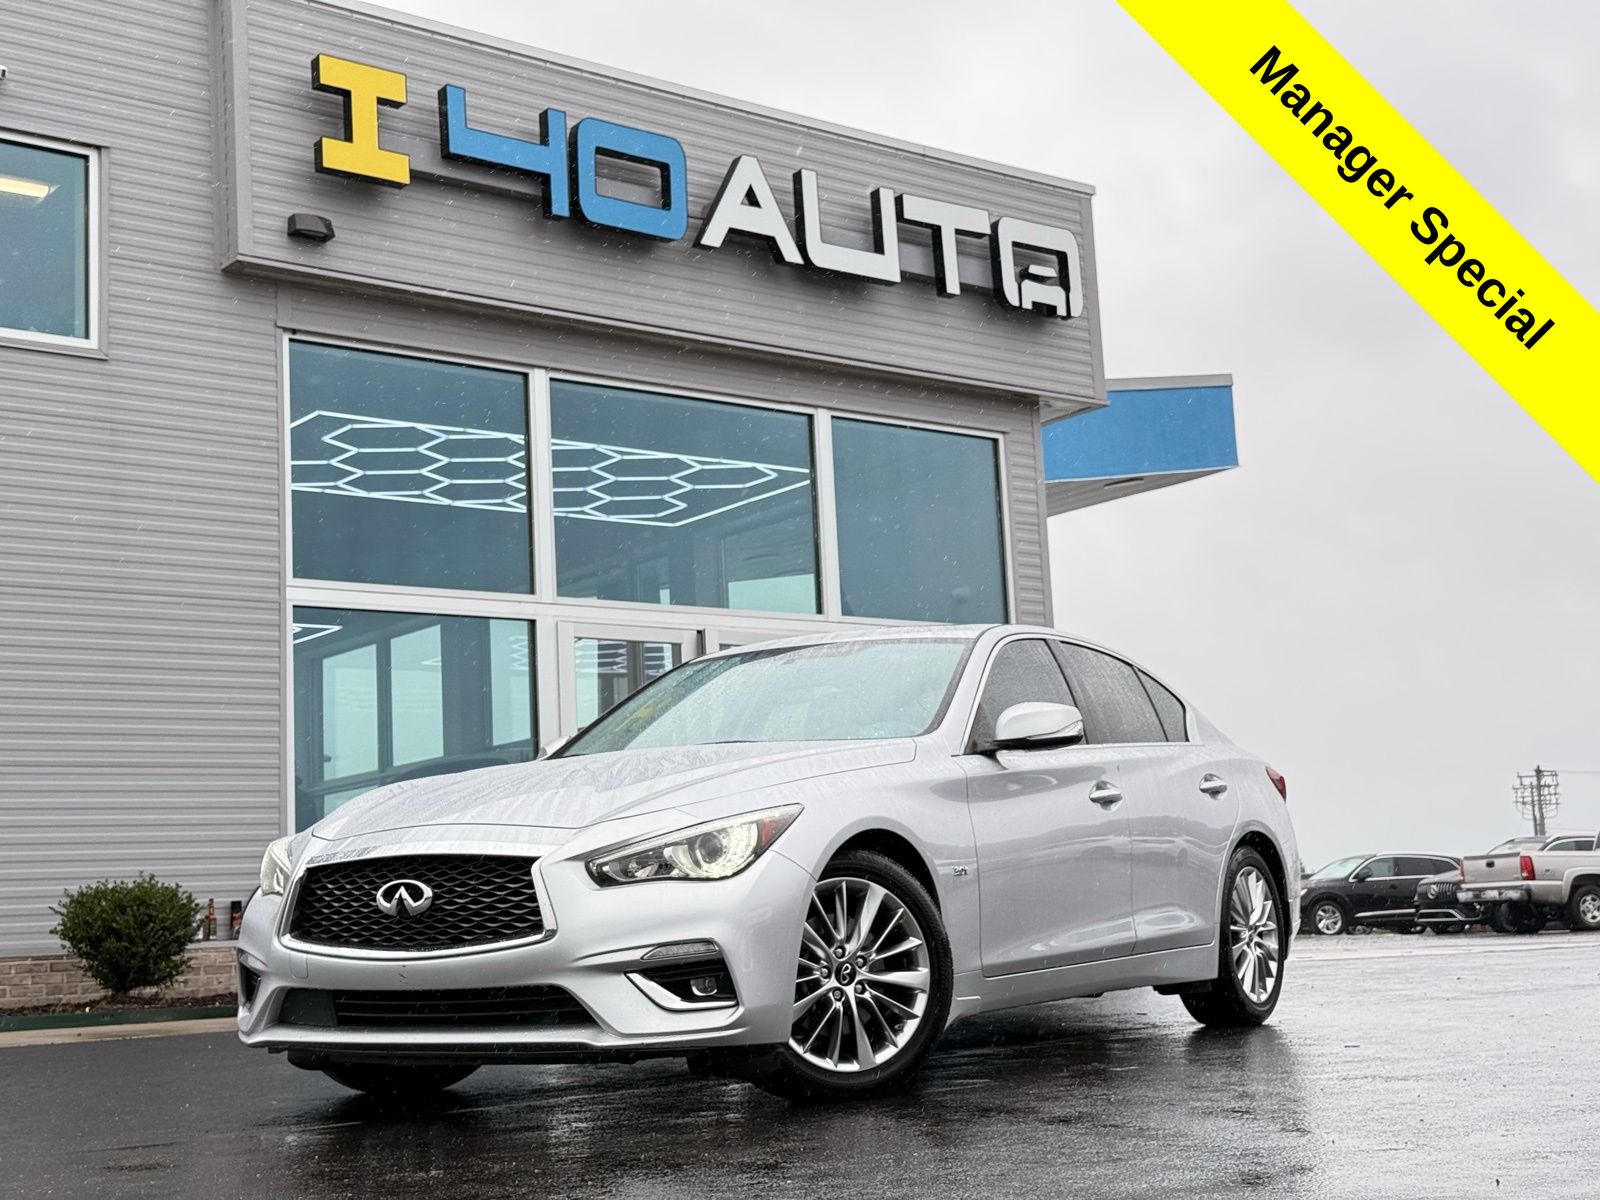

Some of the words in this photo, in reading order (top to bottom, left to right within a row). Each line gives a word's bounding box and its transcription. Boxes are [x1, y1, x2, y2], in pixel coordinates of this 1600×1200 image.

[315, 54, 411, 185] I
[440, 84, 688, 240] 40
[701, 156, 1083, 318] AUTO
